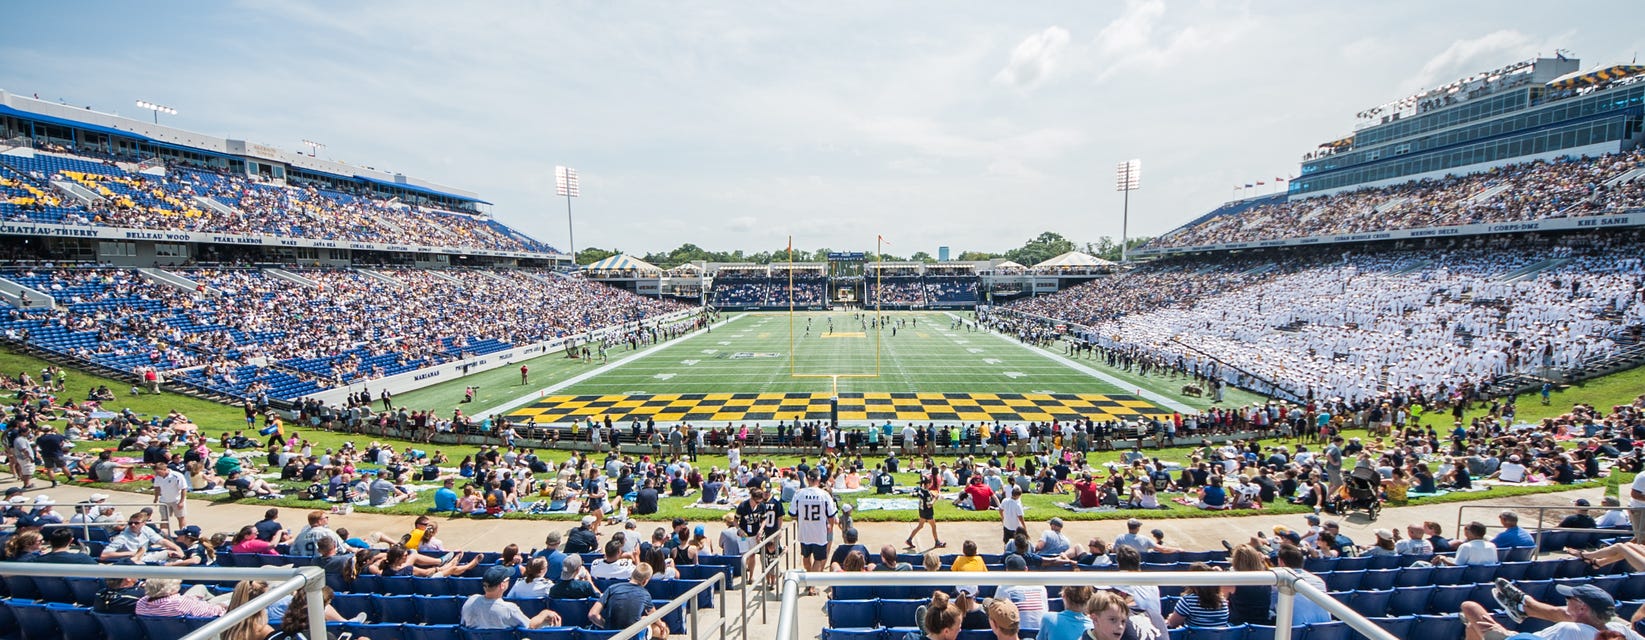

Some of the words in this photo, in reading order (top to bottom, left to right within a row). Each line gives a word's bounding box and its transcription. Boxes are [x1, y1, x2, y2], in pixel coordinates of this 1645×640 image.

[1494, 223, 1539, 231] CORPS-DMZ
[1577, 219, 1597, 227] KHE
[1601, 217, 1629, 225] SANH
[0, 225, 98, 237] CHATEAU-THIERRY
[414, 371, 439, 381] MARIANAS
[880, 476, 890, 486] 12
[803, 504, 821, 521] 12
